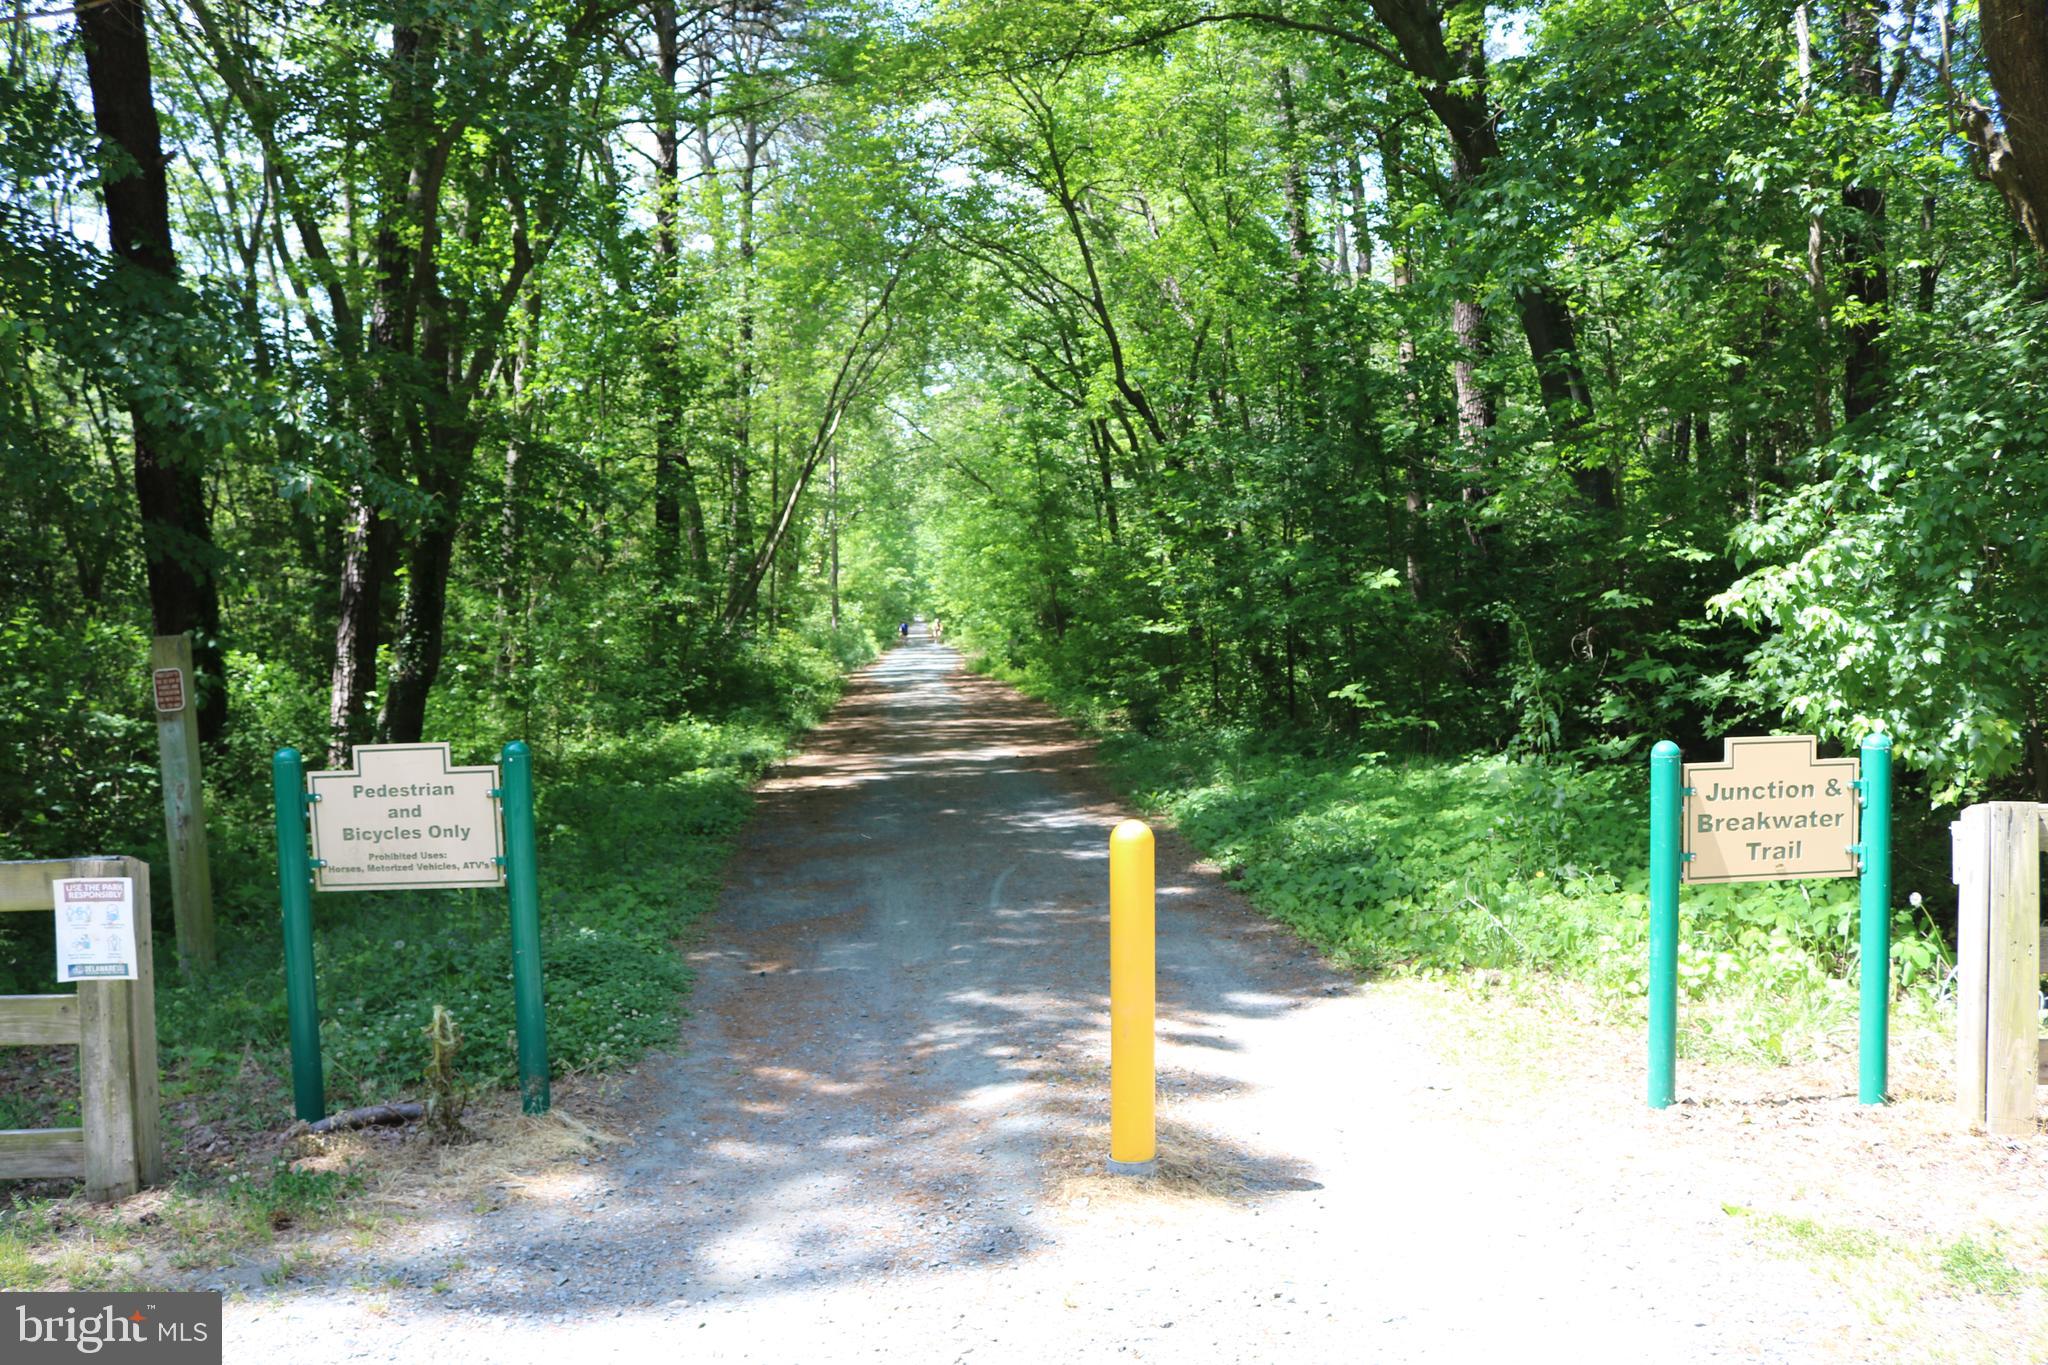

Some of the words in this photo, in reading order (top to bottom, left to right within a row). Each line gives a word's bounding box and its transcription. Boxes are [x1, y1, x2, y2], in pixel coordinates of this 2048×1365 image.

[352, 783, 455, 798] Pedestrian
[1705, 780, 1815, 801] Junction
[1825, 778, 1842, 797] &
[388, 805, 422, 819] and
[1697, 811, 1845, 833] Breakwater
[342, 826, 422, 844] Bicycles
[428, 824, 471, 841] Only
[368, 852, 418, 861] Prohibited
[420, 851, 447, 860] Uses:
[1746, 840, 1803, 861] Trail
[328, 865, 364, 873] Horses,
[367, 863, 414, 872] Motorized
[417, 861, 460, 871] Vehicles,
[463, 861, 490, 869] ATV's
[65, 884, 83, 892] USE
[84, 883, 100, 891] THE
[102, 883, 123, 891] PARK
[68, 891, 122, 899] RESPONSIBLY
